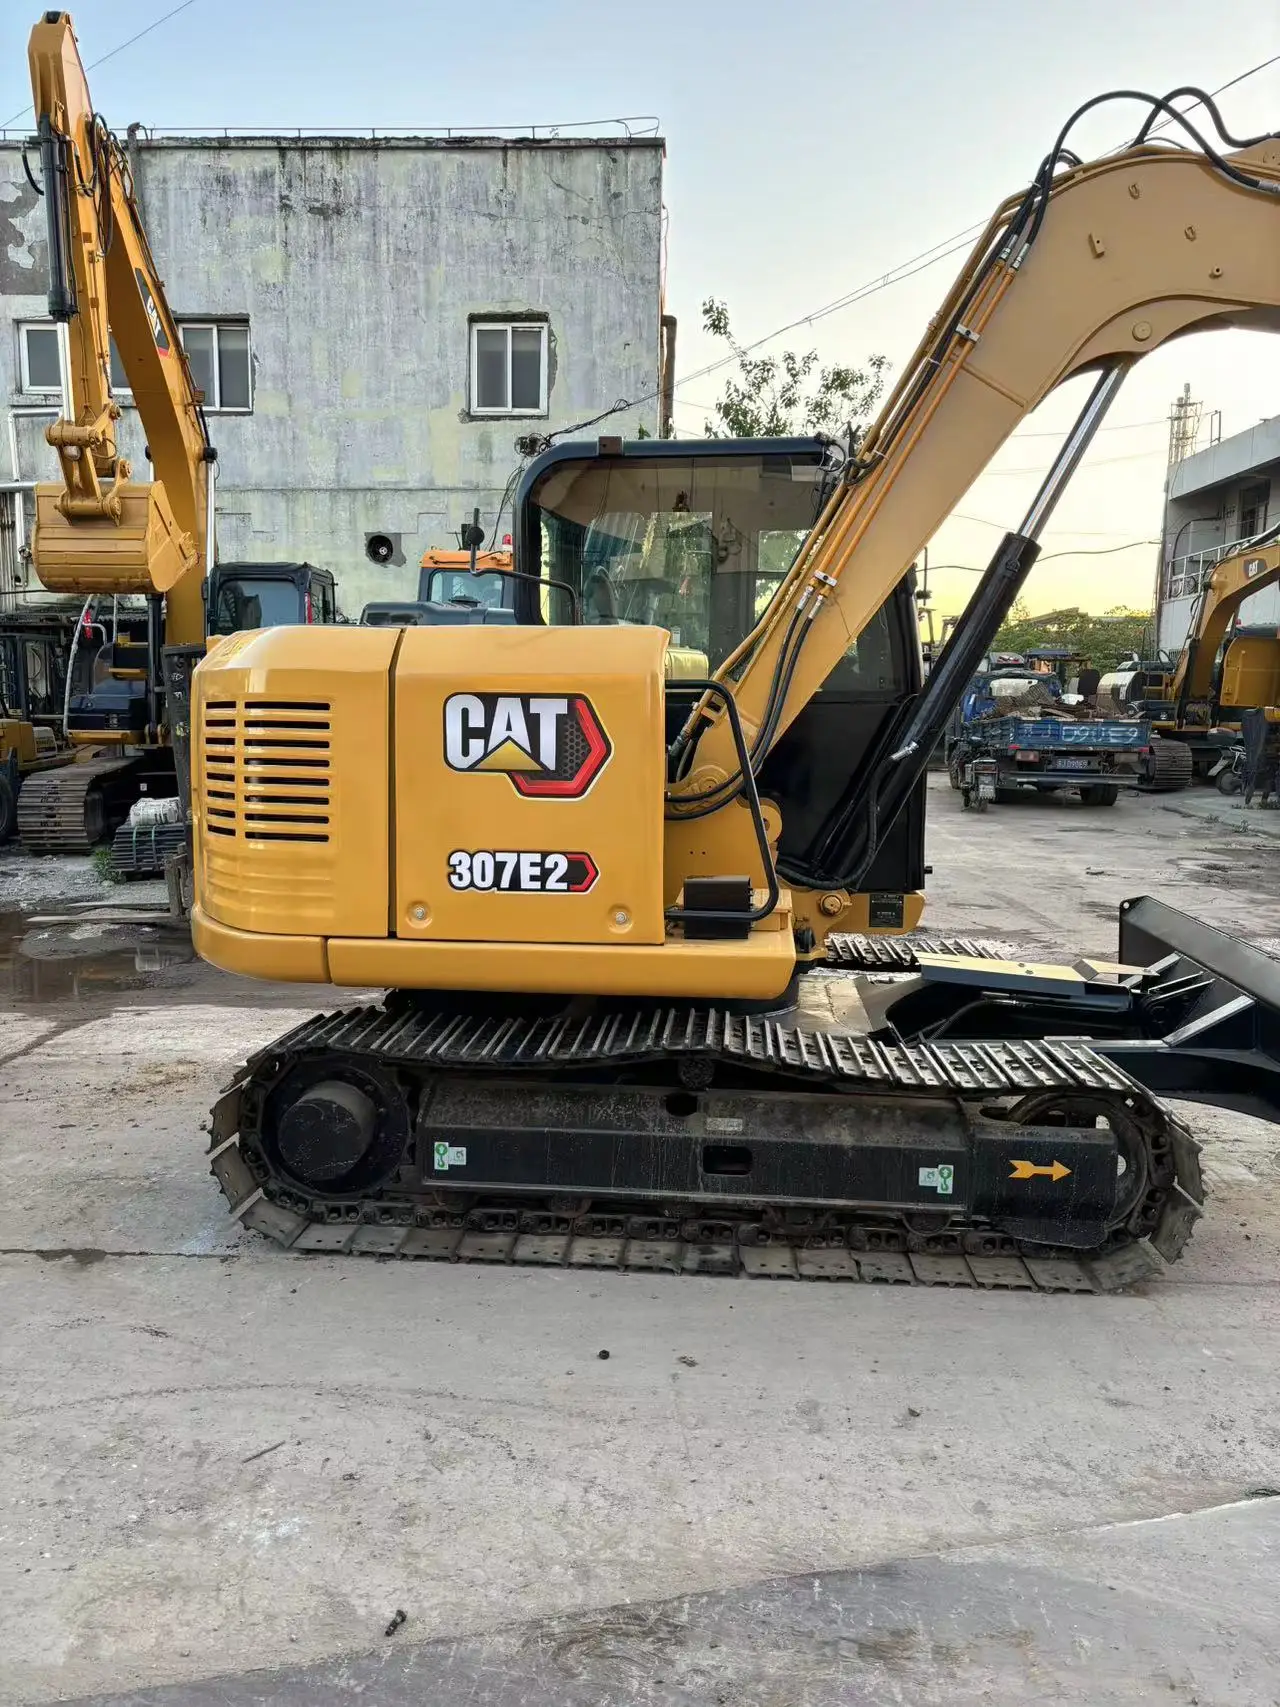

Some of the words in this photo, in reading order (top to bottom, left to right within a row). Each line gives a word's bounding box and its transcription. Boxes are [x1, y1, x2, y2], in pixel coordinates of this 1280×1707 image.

[147, 295, 162, 339] CAT
[1248, 559, 1259, 578] CAT
[445, 694, 568, 771] CAT
[449, 851, 569, 890] 307E2
